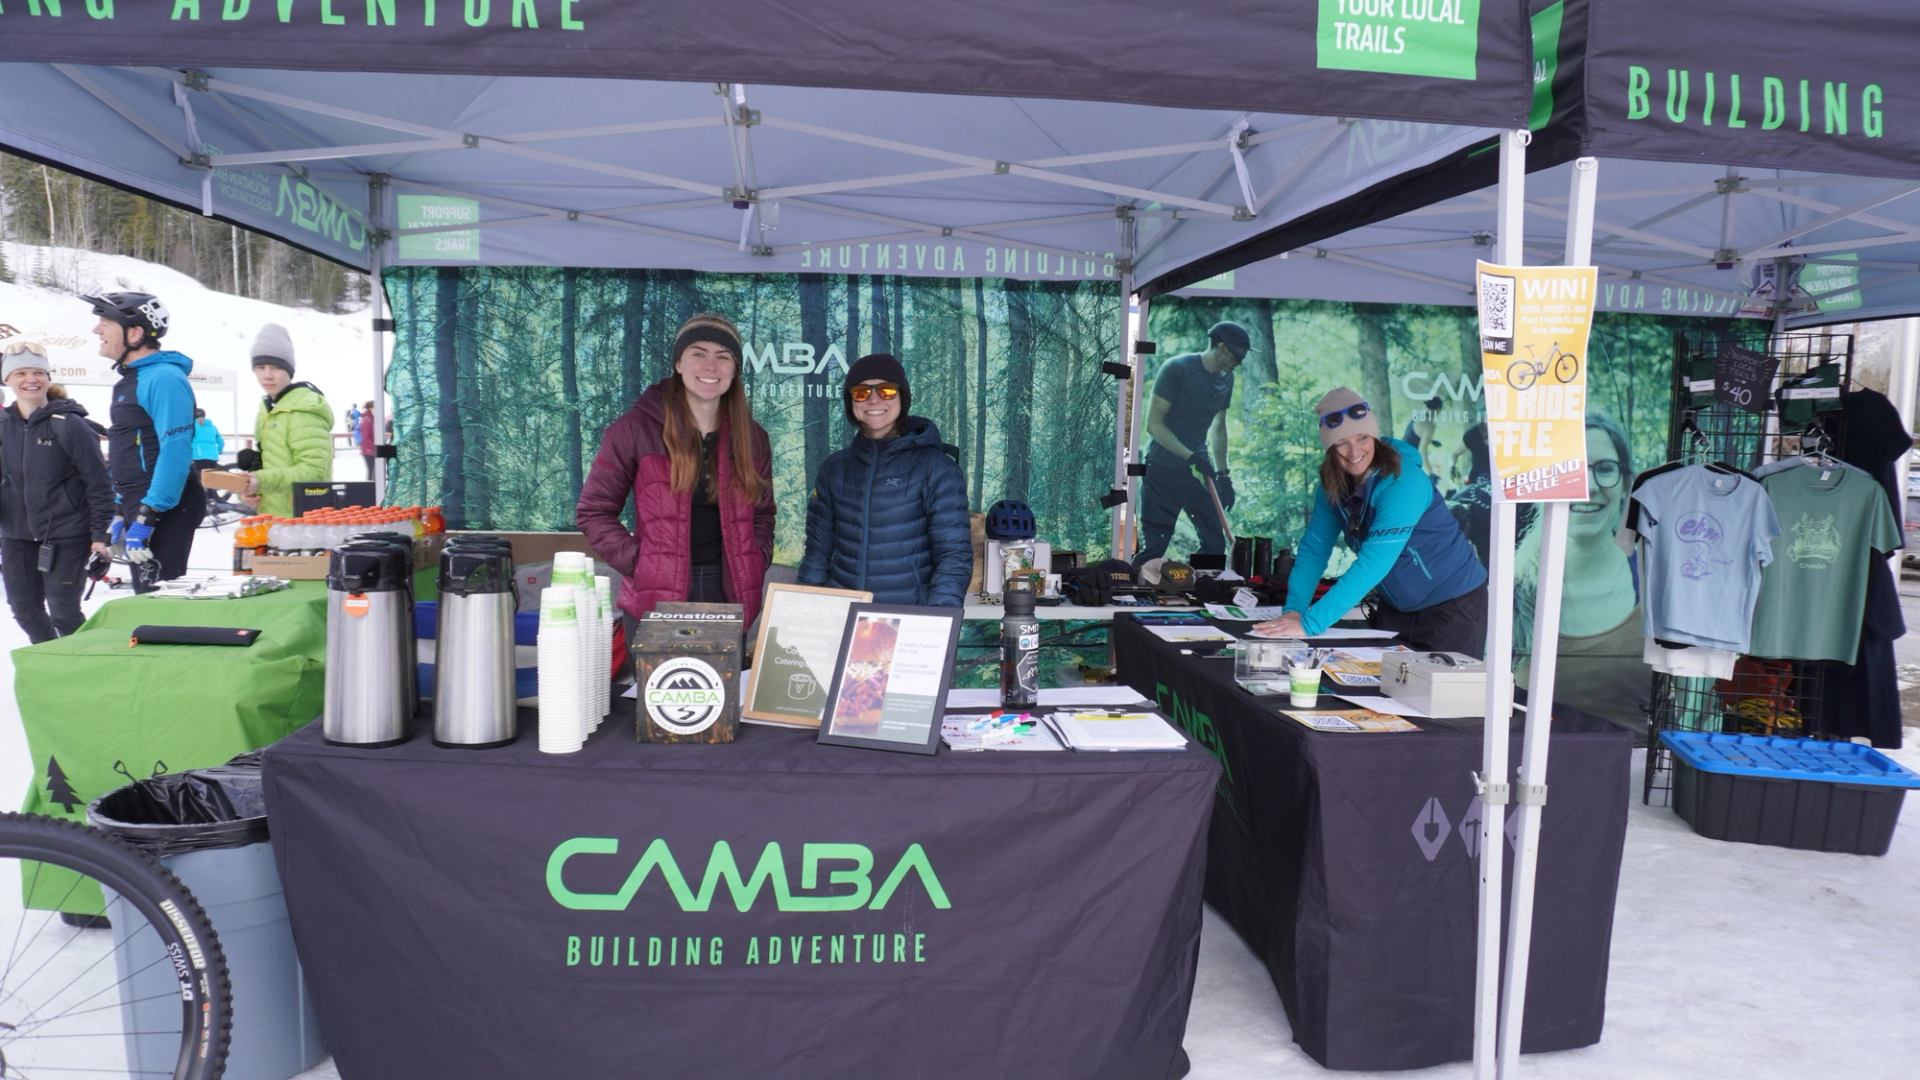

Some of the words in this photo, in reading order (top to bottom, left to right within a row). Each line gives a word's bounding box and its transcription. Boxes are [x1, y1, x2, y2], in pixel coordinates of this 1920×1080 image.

[1401, 0, 1465, 25] LOCAL
[1334, 22, 1406, 54] TRAILS
[1627, 66, 1883, 138] BUILDING
[1522, 276, 1588, 301] WIN!
[742, 342, 851, 375] MBA
[1402, 371, 1485, 402] CAM
[1515, 383, 1583, 420] RIDE
[1489, 421, 1553, 457] FFLE
[1516, 476, 1560, 497] CYCLE
[648, 611, 736, 620] Donations
[648, 690, 721, 704] CAMBA
[545, 836, 952, 913] CAMBA
[167, 941, 190, 978] SWISS
[566, 936, 724, 966] BUILDING
[745, 933, 927, 965] ADVENTURE
